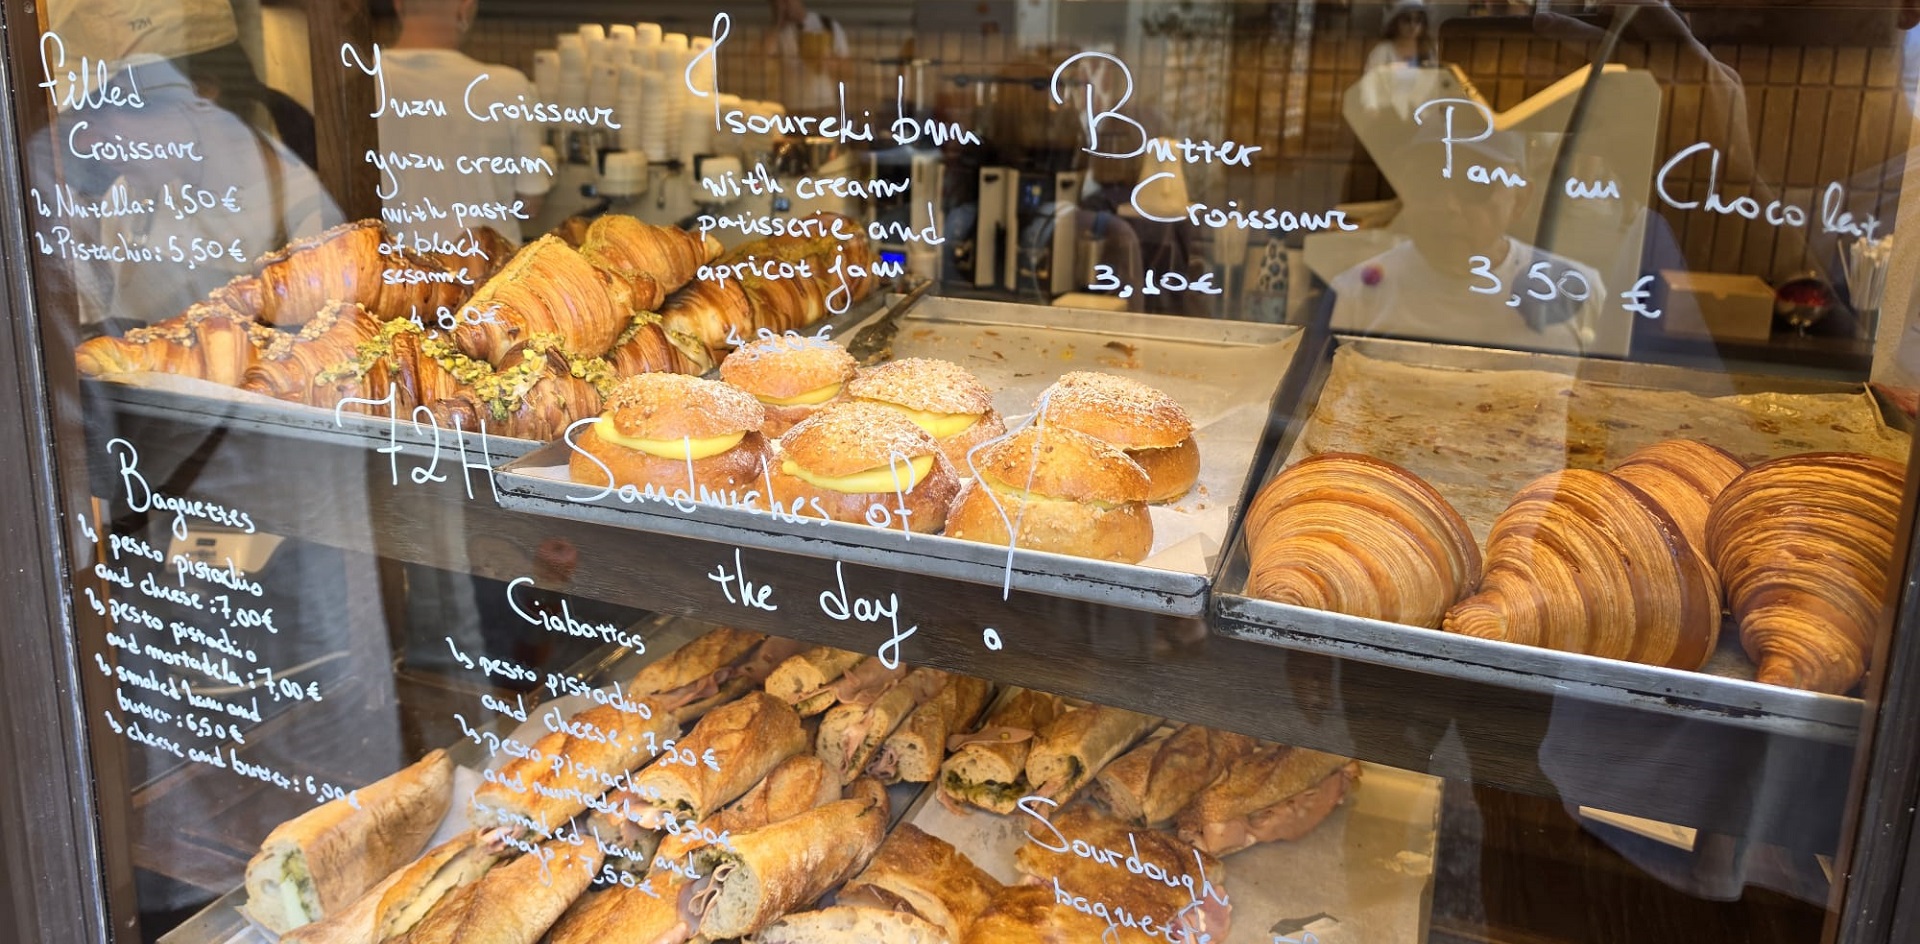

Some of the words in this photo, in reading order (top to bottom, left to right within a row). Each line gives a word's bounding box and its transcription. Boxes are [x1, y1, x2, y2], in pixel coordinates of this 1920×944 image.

[341, 42, 447, 119] Yuzu
[891, 75, 981, 146] bun
[1051, 51, 1262, 168] Butter
[55, 183, 154, 218] Nutella:
[365, 149, 445, 199] yuzu
[456, 154, 554, 176] cream
[703, 162, 783, 197] with
[795, 177, 910, 199] cream
[381, 197, 447, 223] with
[451, 199, 530, 227] paste
[697, 209, 854, 242] patisserie
[868, 201, 945, 245] and
[51, 226, 162, 262] Pistachio:
[378, 231, 405, 258] of
[413, 229, 489, 260] black
[382, 267, 475, 285] sesame
[696, 255, 813, 289] apricot
[825, 245, 904, 315] jam
[1088, 265, 1223, 298] 3,10€
[106, 437, 255, 541] Baguettes
[335, 381, 500, 503] 72H
[563, 417, 831, 527] Sandwiches
[865, 450, 915, 541] of
[94, 563, 134, 588] and
[140, 573, 203, 610] cheese
[109, 533, 164, 561] pesto
[172, 553, 263, 597] pistachio
[108, 598, 164, 630] pesto
[170, 621, 257, 664] pistachio
[507, 577, 645, 655] Ciabattas
[708, 547, 778, 611] the
[819, 560, 918, 670] day
[106, 632, 141, 655] and
[115, 666, 181, 700] smoked
[182, 679, 223, 712] ham
[226, 697, 262, 723] and
[479, 655, 537, 682] pesto
[545, 672, 652, 720] pistachio
[481, 693, 527, 723] and
[126, 721, 185, 758] cheese
[188, 746, 227, 768] and
[483, 732, 541, 762] pesto
[546, 753, 661, 798] pistachio
[484, 768, 526, 793] and
[497, 808, 584, 846] smoked
[592, 826, 644, 862] ham
[655, 851, 701, 880] and
[1017, 795, 1230, 934] Sourdough
